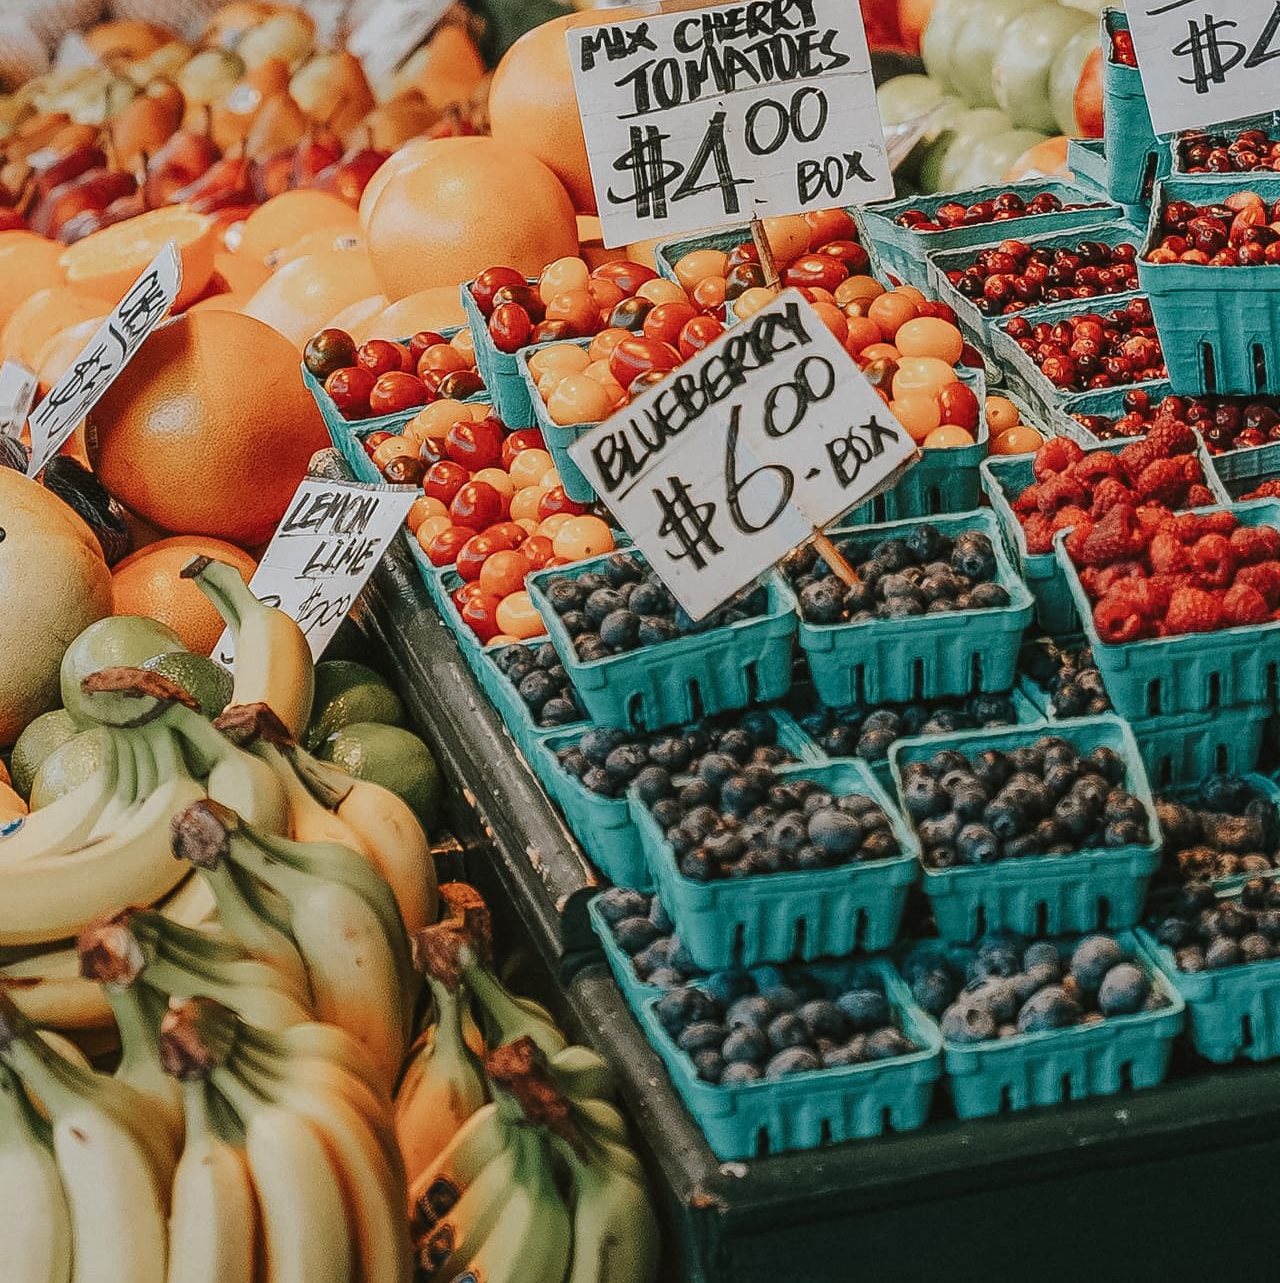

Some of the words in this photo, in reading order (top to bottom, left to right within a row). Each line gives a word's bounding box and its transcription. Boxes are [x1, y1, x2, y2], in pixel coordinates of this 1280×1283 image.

[581, 22, 657, 72] MIX
[614, 29, 851, 115] TOMATOES
[607, 86, 828, 219] $4.00
[797, 150, 875, 205] BOX
[591, 302, 812, 493] BLUEBERRY
[652, 355, 835, 571] $6.00
[825, 414, 899, 489] BOX
[281, 491, 380, 536] LEMON
[302, 537, 382, 578] LIME
